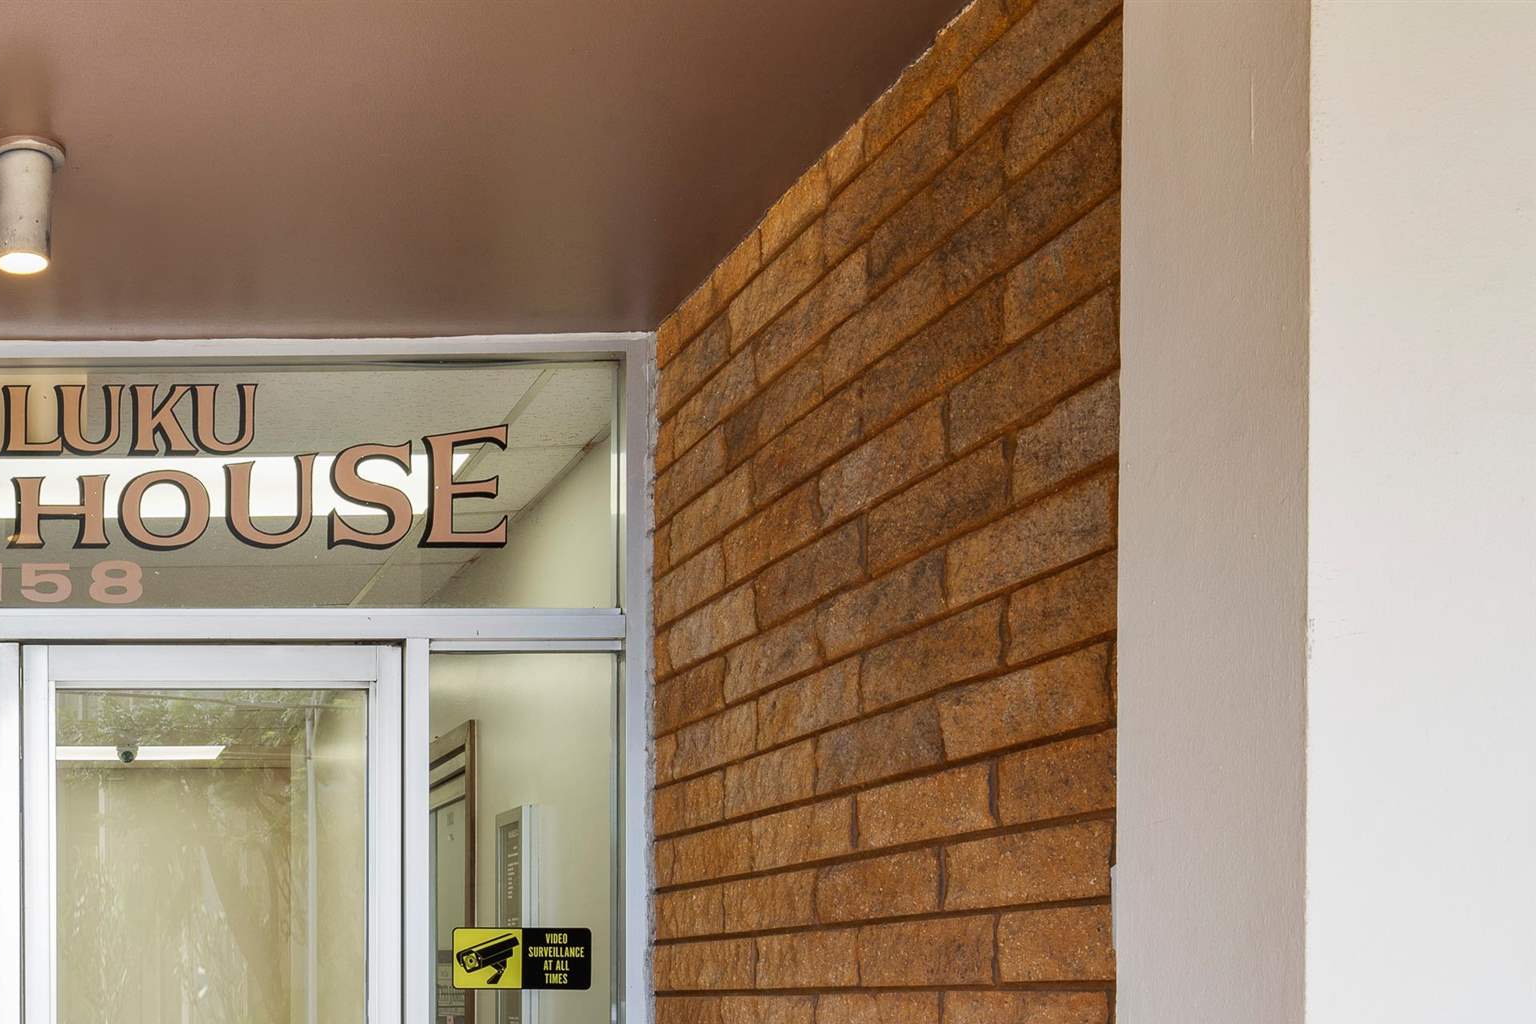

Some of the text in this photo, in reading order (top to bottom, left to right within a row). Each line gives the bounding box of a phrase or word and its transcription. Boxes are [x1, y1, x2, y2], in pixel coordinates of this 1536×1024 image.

[7, 425, 509, 550] HOUSE
[545, 933, 568, 944] VIDEO
[528, 946, 585, 958] SURVEILLANCE
[543, 960, 570, 971] AT ALL
[545, 973, 568, 985] TIMES
